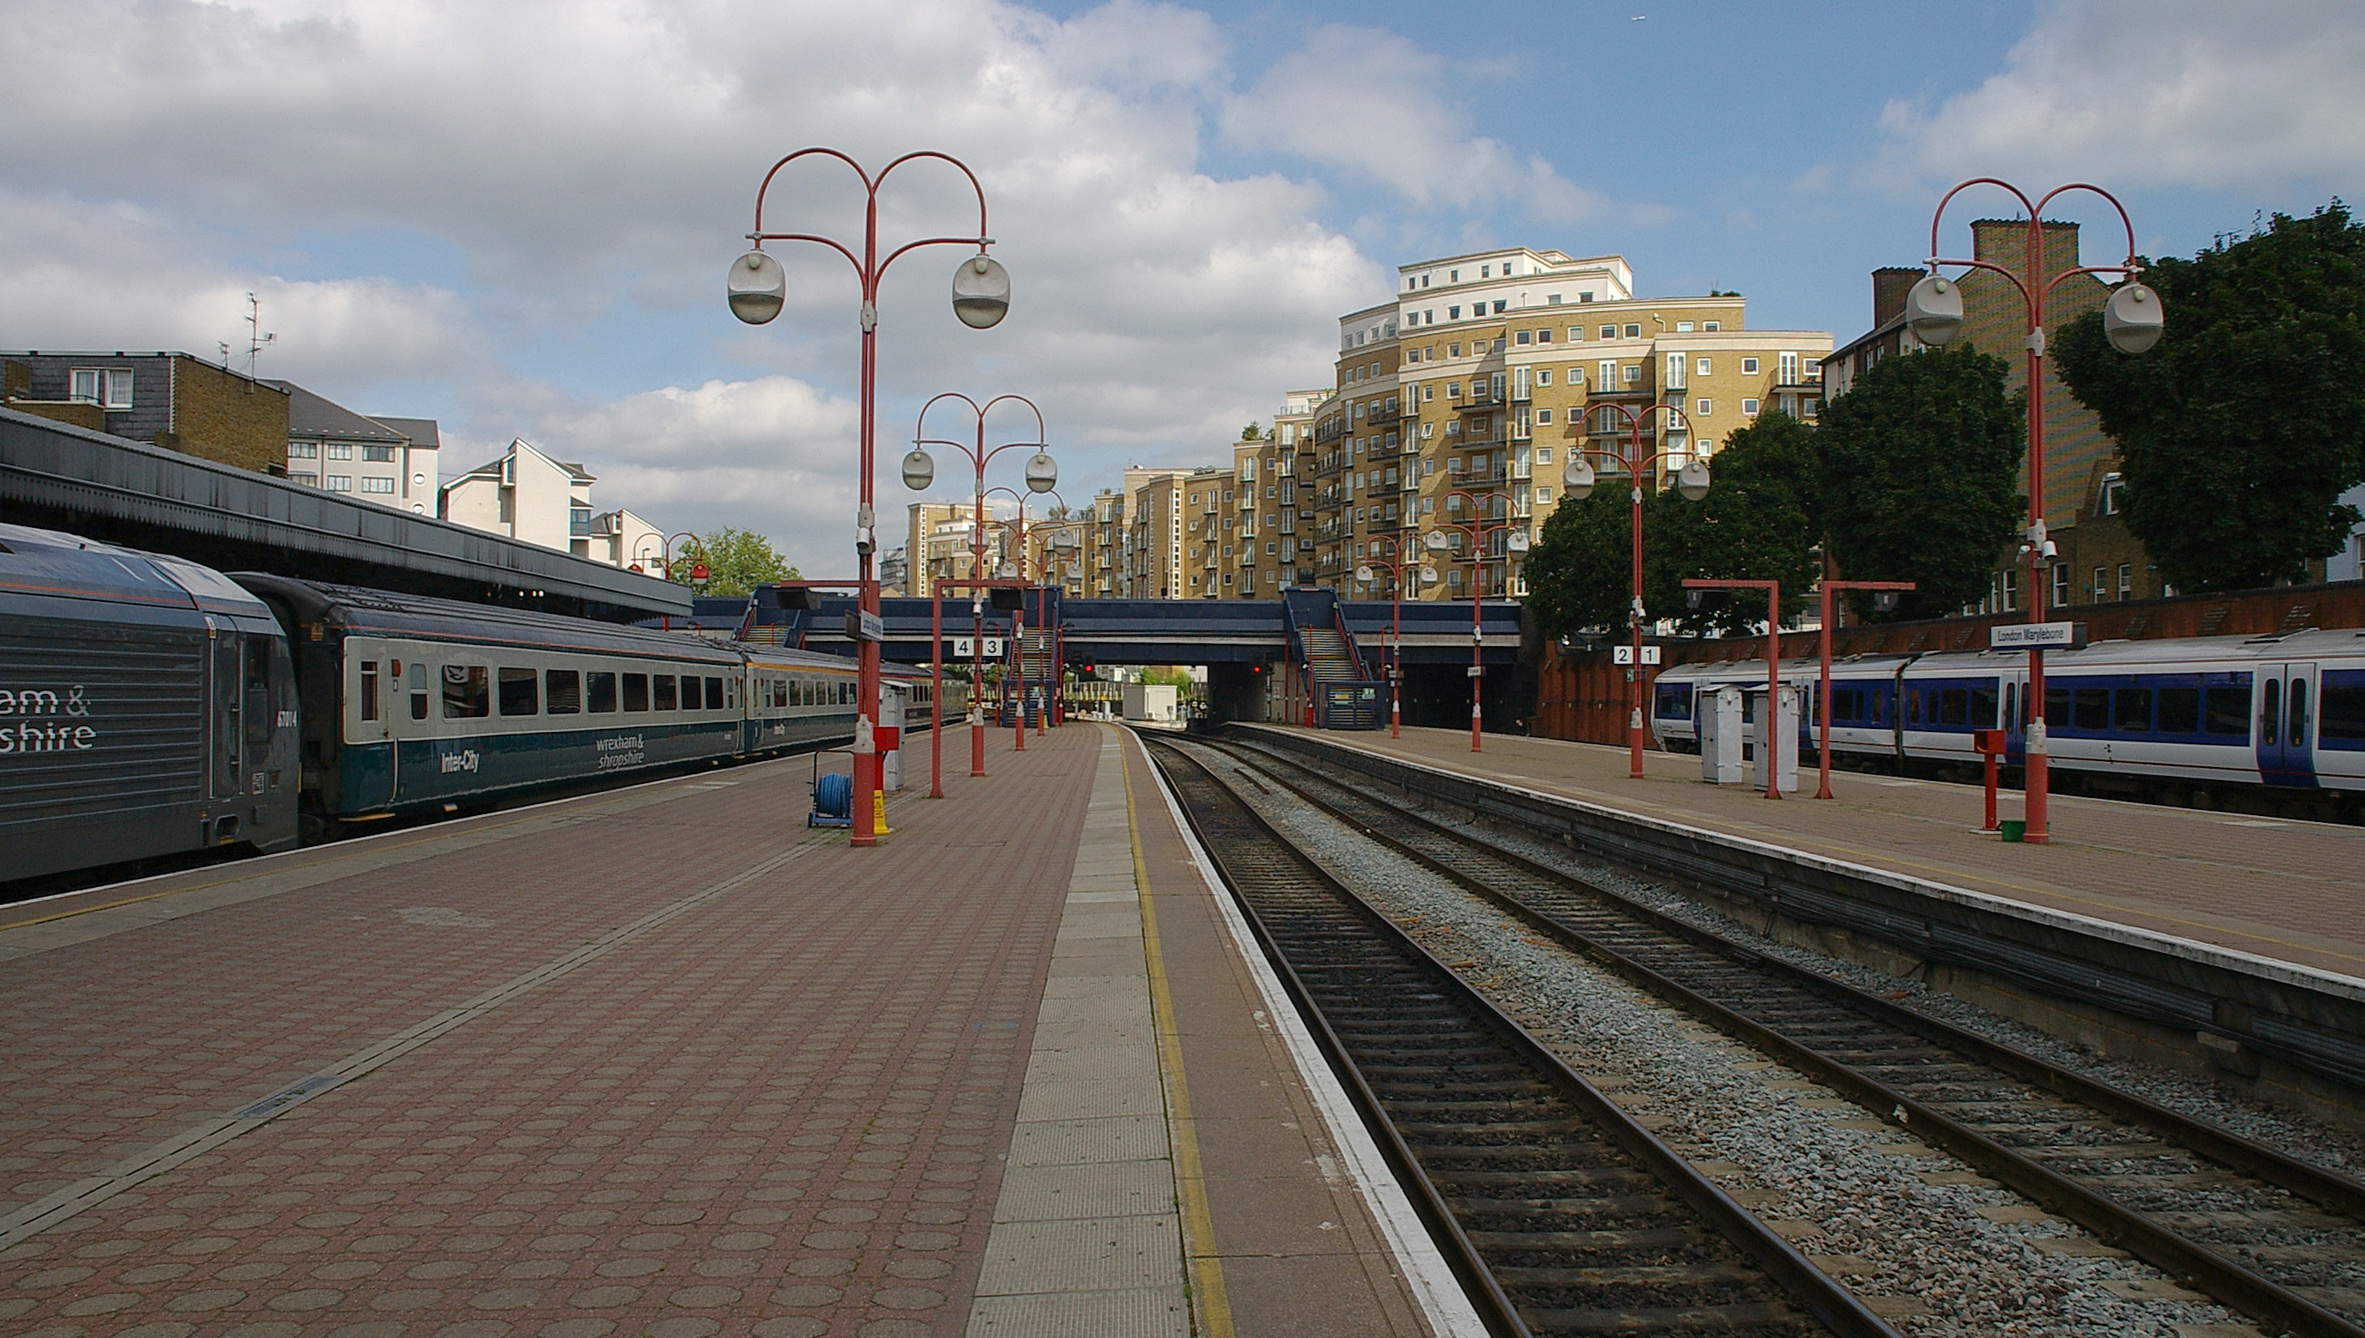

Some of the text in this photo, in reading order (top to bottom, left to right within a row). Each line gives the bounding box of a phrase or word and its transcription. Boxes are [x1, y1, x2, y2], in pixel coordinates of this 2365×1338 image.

[1997, 627, 2064, 643] London Marylebone
[959, 640, 969, 654] 4
[987, 640, 997, 654] 3
[1618, 648, 1628, 662] 2
[1645, 648, 1653, 662] 1
[66, 684, 91, 717] &
[441, 749, 480, 774] Inter-City
[598, 750, 645, 771] shropshire
